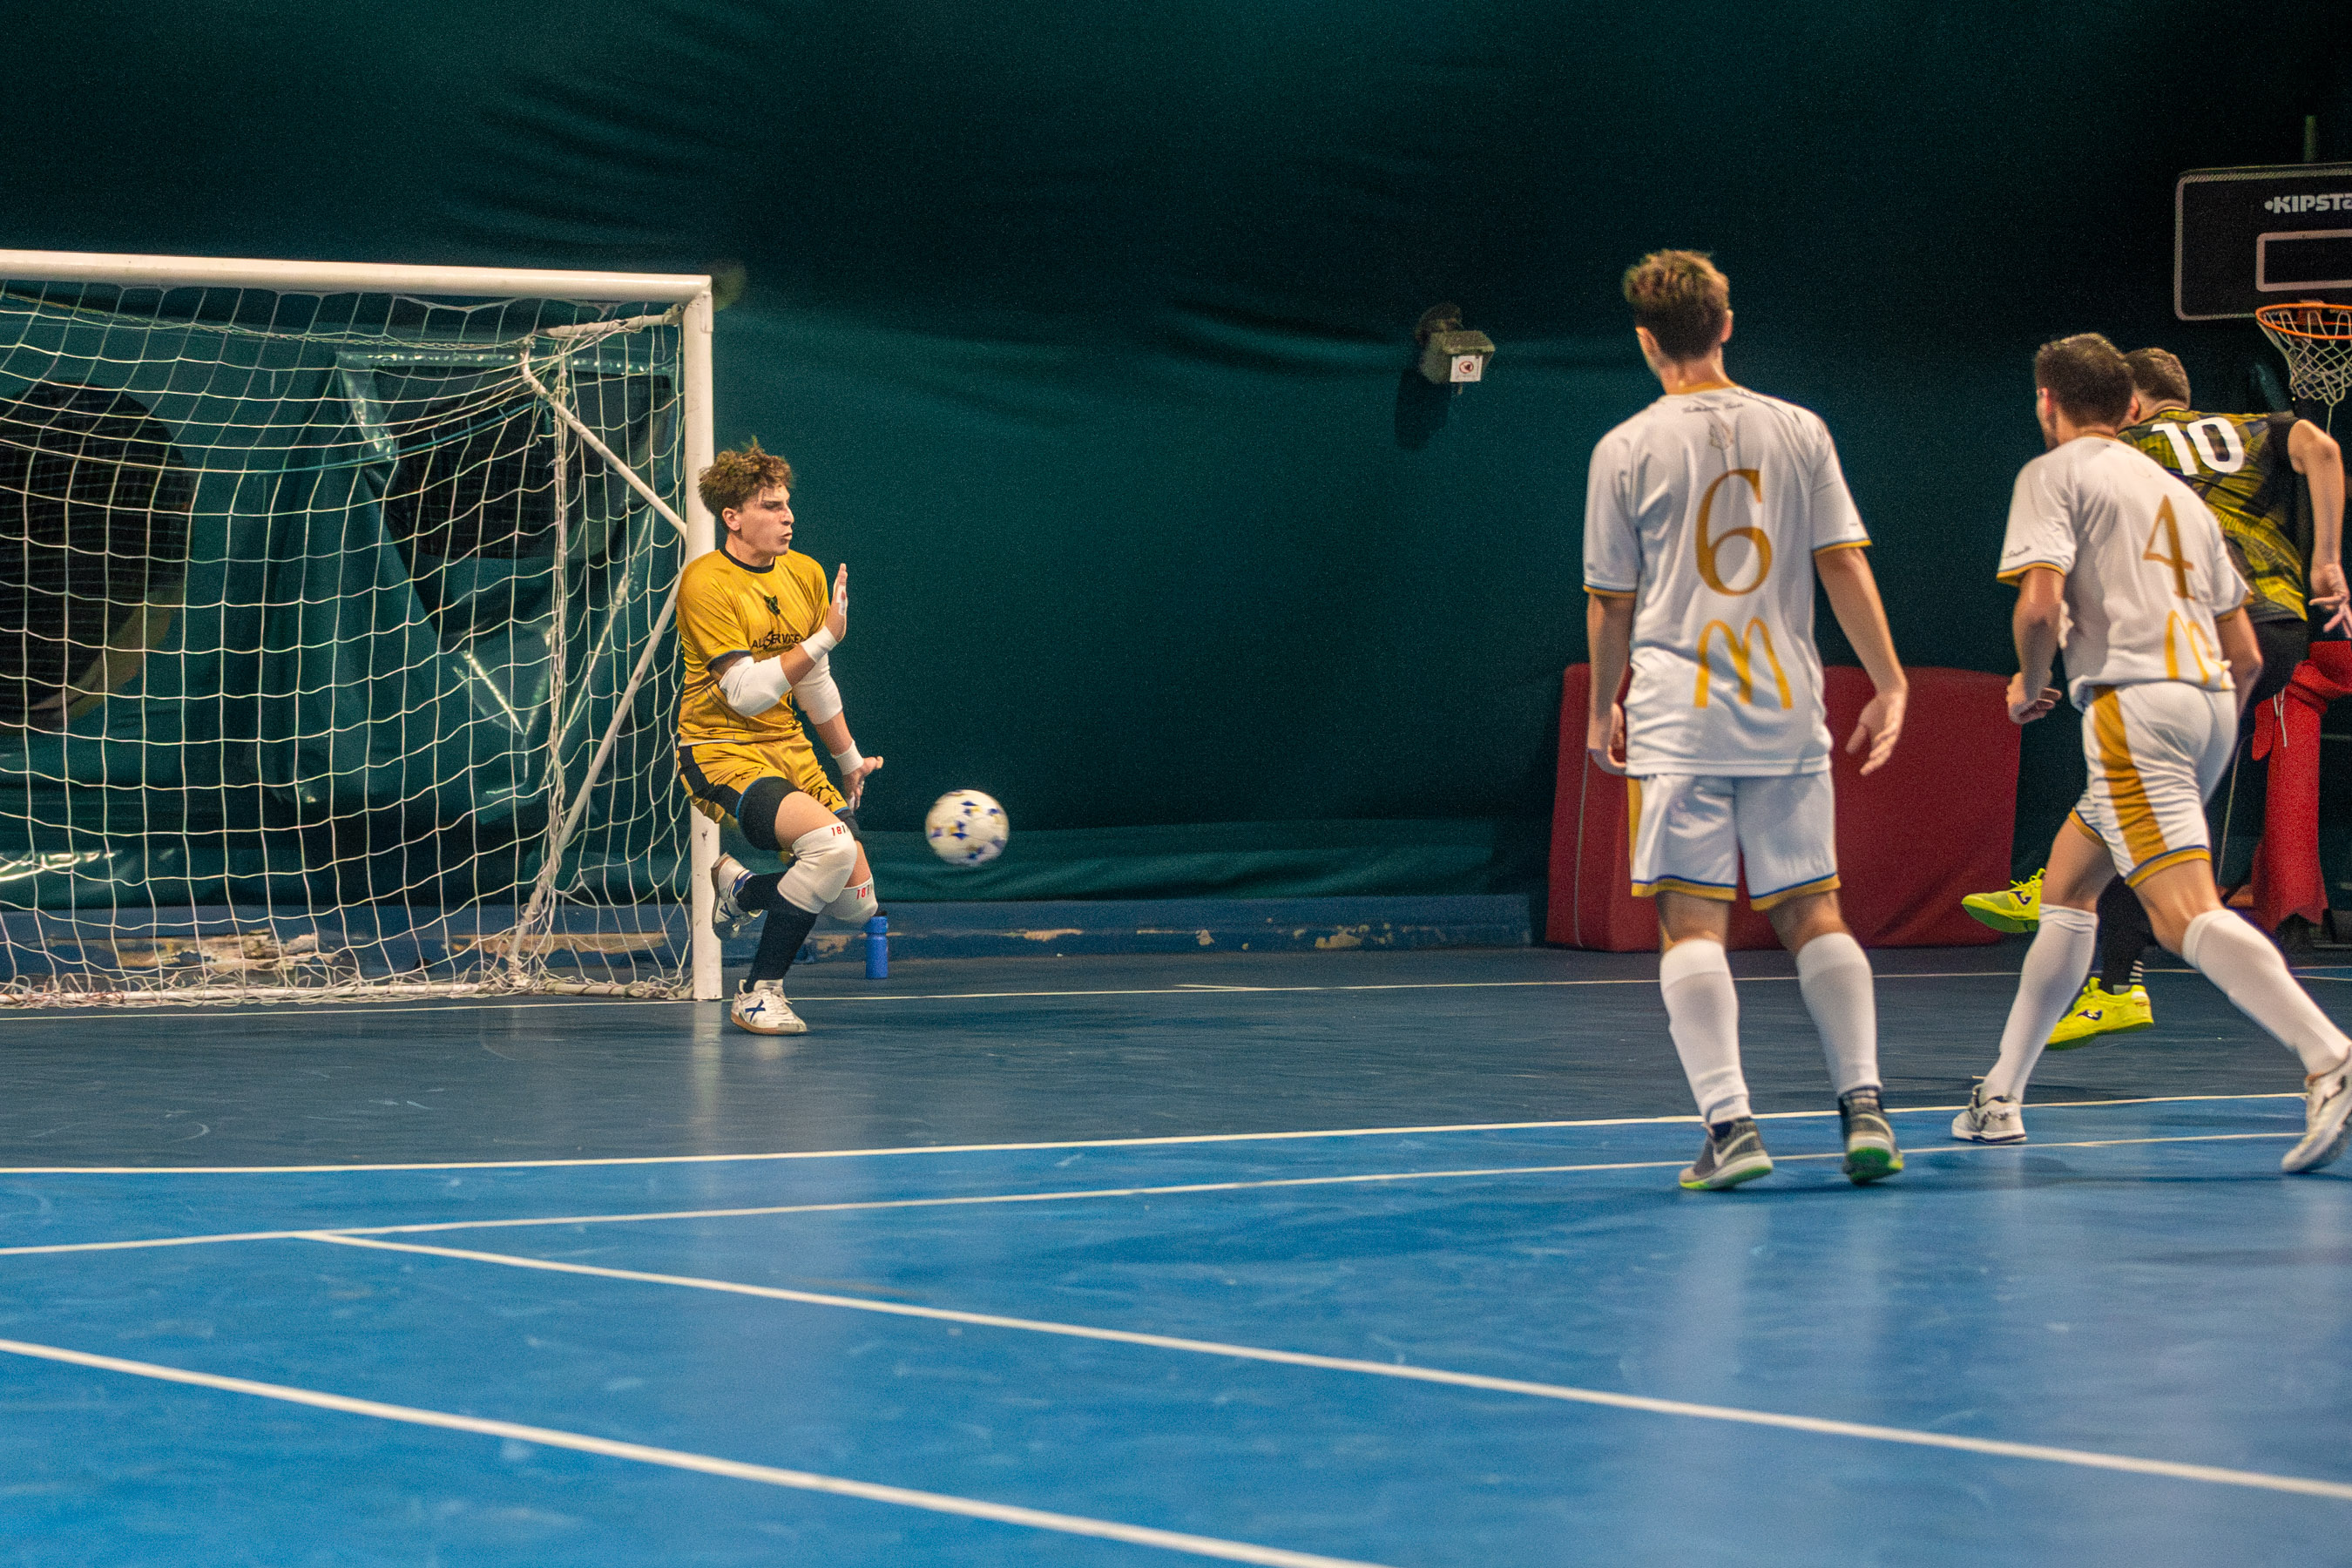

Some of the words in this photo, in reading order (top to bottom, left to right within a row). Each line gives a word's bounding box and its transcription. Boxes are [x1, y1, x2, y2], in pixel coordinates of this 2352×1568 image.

[2152, 416, 2246, 476] 10
[1694, 469, 1773, 597] 6
[2142, 493, 2196, 601] 4
